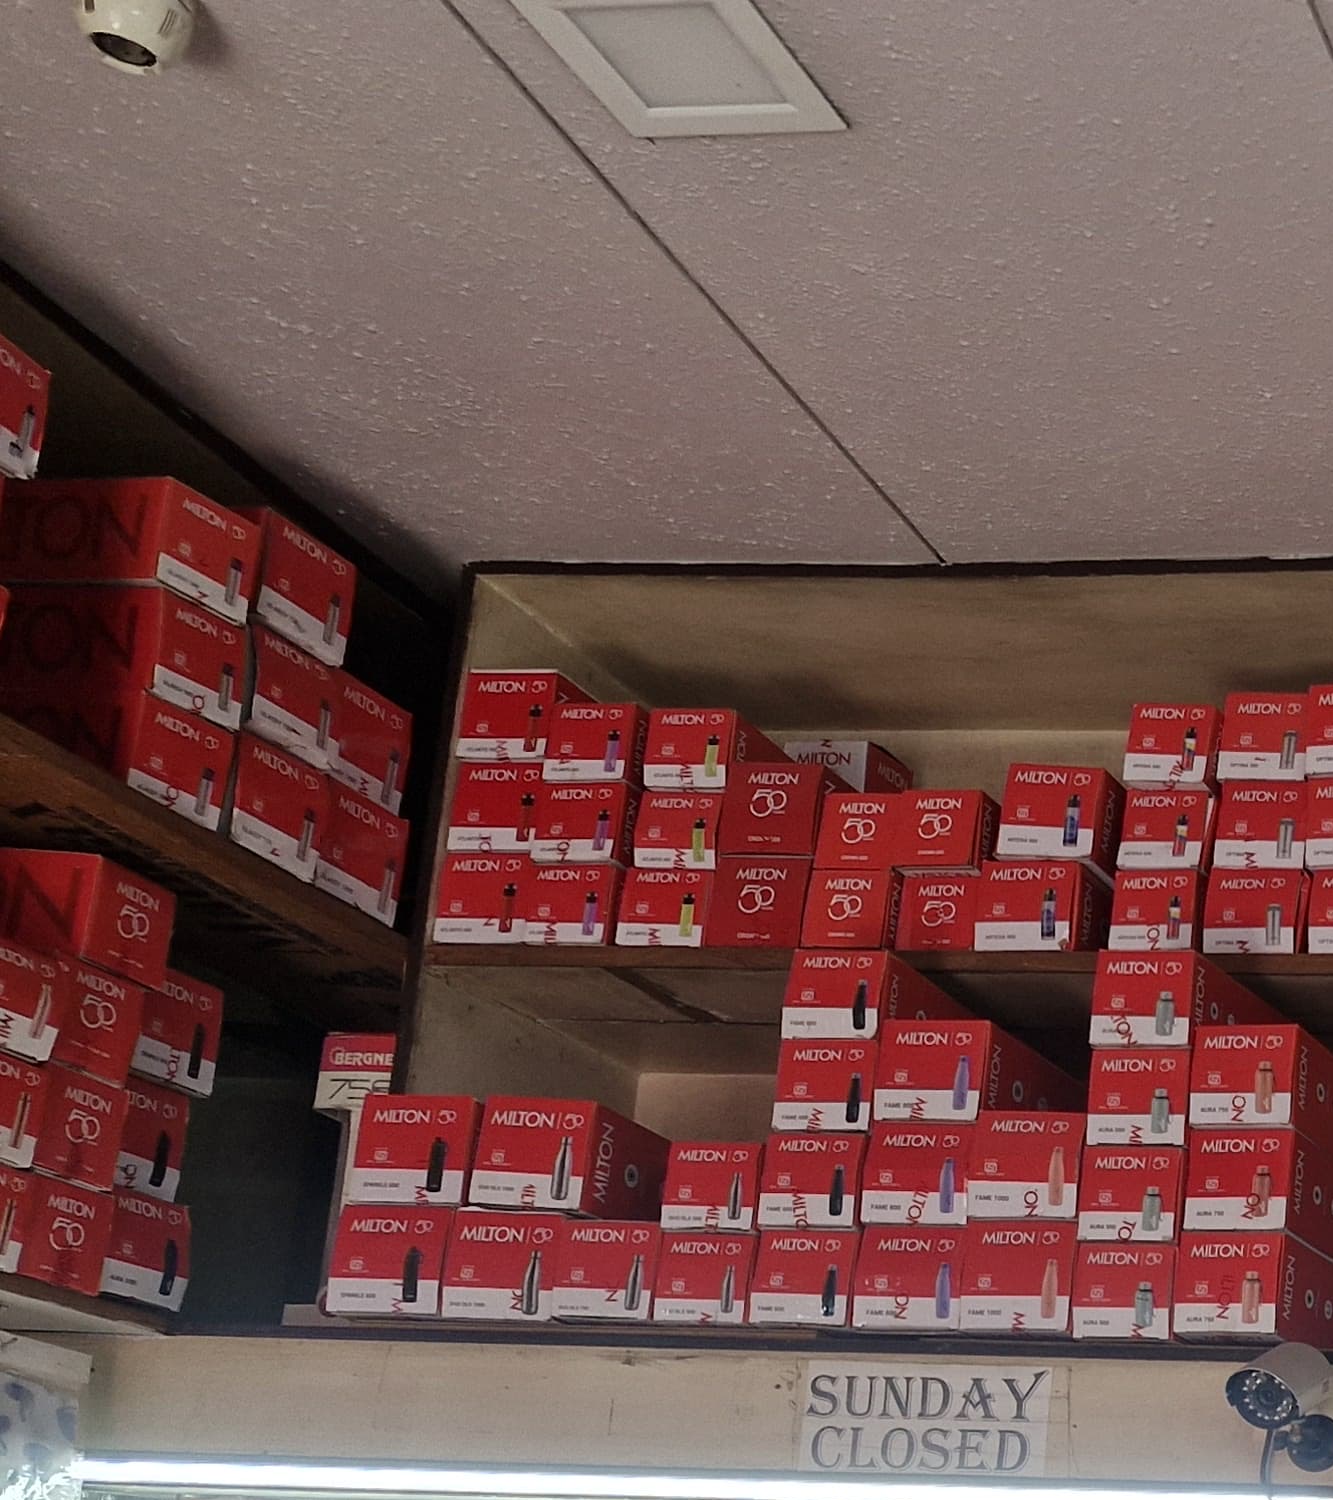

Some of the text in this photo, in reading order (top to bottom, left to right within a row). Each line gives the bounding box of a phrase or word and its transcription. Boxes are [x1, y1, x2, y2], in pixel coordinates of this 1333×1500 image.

[182, 497, 228, 534] MILTON
[479, 681, 525, 693] MILTON
[796, 752, 851, 766] MILTON
[748, 773, 798, 785] MILTON
[1015, 771, 1067, 785] MILTON
[916, 799, 962, 809] MILTON
[116, 881, 159, 913] MILTON
[803, 956, 850, 969] MILTON
[1204, 1035, 1258, 1049] MILTON
[373, 1109, 431, 1123] MILTON
[491, 1111, 555, 1128] MILTON
[991, 1120, 1045, 1133] MILTON
[592, 1123, 616, 1202] MILTON
[1191, 1243, 1244, 1258] MILTON
[806, 1370, 1049, 1422] SUNDAY
[811, 1426, 1031, 1473] CLOSED
